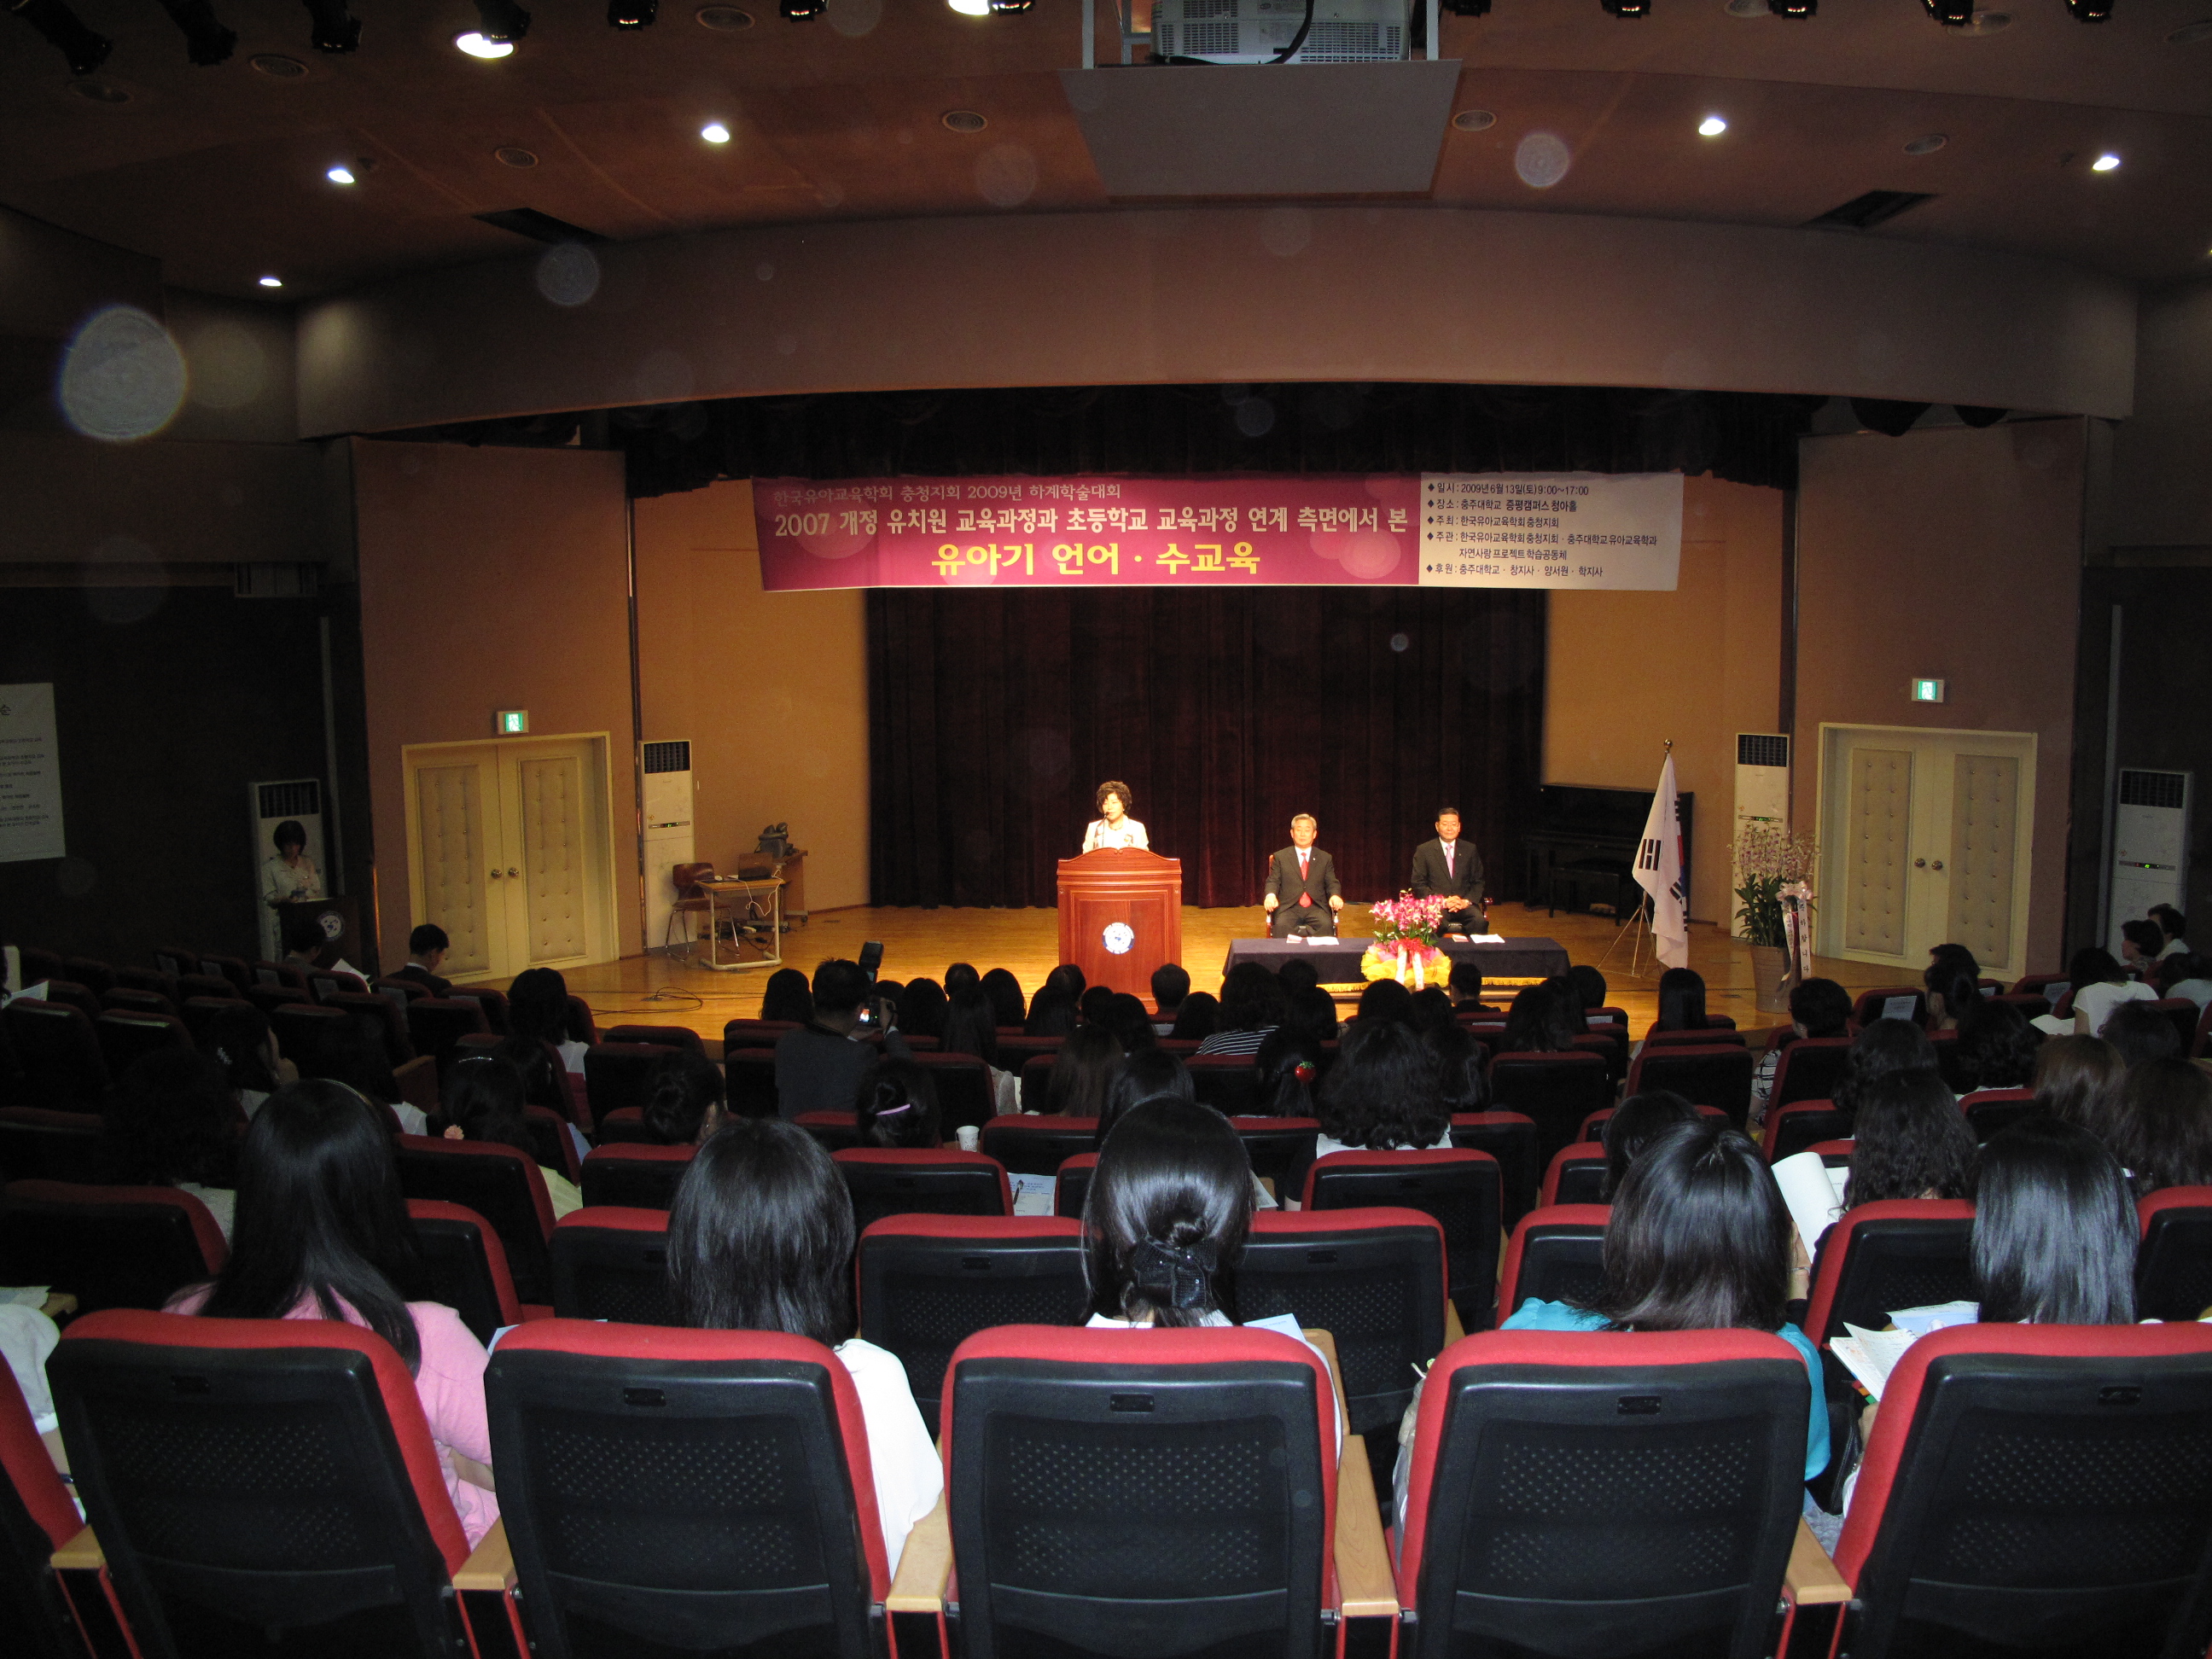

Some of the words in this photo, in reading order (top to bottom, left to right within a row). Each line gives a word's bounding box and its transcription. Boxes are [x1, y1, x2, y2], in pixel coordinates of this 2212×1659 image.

[774, 486, 893, 507] 한국유아교육학회
[900, 485, 960, 503] 충청지회
[968, 485, 1022, 501] 2009년
[1029, 484, 1121, 501] 하계학술대회
[1461, 483, 1489, 493] 2009년
[1490, 484, 1504, 494] 6월
[1538, 485, 1589, 495] 9:00~17:00
[1461, 499, 1502, 510] 충주대학교
[1506, 499, 1550, 511] 증평캠퍼스
[775, 513, 830, 536] 2007
[840, 510, 878, 535] 개정
[887, 509, 946, 534] 유치원
[956, 508, 1058, 533] 교육과정과
[1067, 507, 1149, 533] 초등학교
[1156, 507, 1238, 533] 교육과정
[1249, 507, 1288, 533] 연계
[1297, 507, 1378, 533] 측면에서
[1388, 508, 1408, 533] 본
[1460, 515, 1525, 527] 한국유아교육학회
[1527, 517, 1559, 528] 충청지회
[1460, 532, 1524, 544] 한국유아교육학회
[1526, 533, 1558, 544] 충청지회
[1567, 533, 1608, 545] 충주대학교
[1609, 534, 1656, 546] 유아교육학과
[932, 543, 1033, 576] 유아기
[1052, 543, 1119, 575] 언어
[1155, 541, 1260, 574] 수교육
[1459, 548, 1491, 559] 자연사랑
[1493, 549, 1526, 560] 프로젝트
[1527, 549, 1567, 561] 학습공동체
[1459, 564, 1500, 575] 충주대학교
[1510, 565, 1534, 576] 창지사
[1544, 566, 1569, 576] 양서원
[1578, 566, 1603, 577] 학지사
